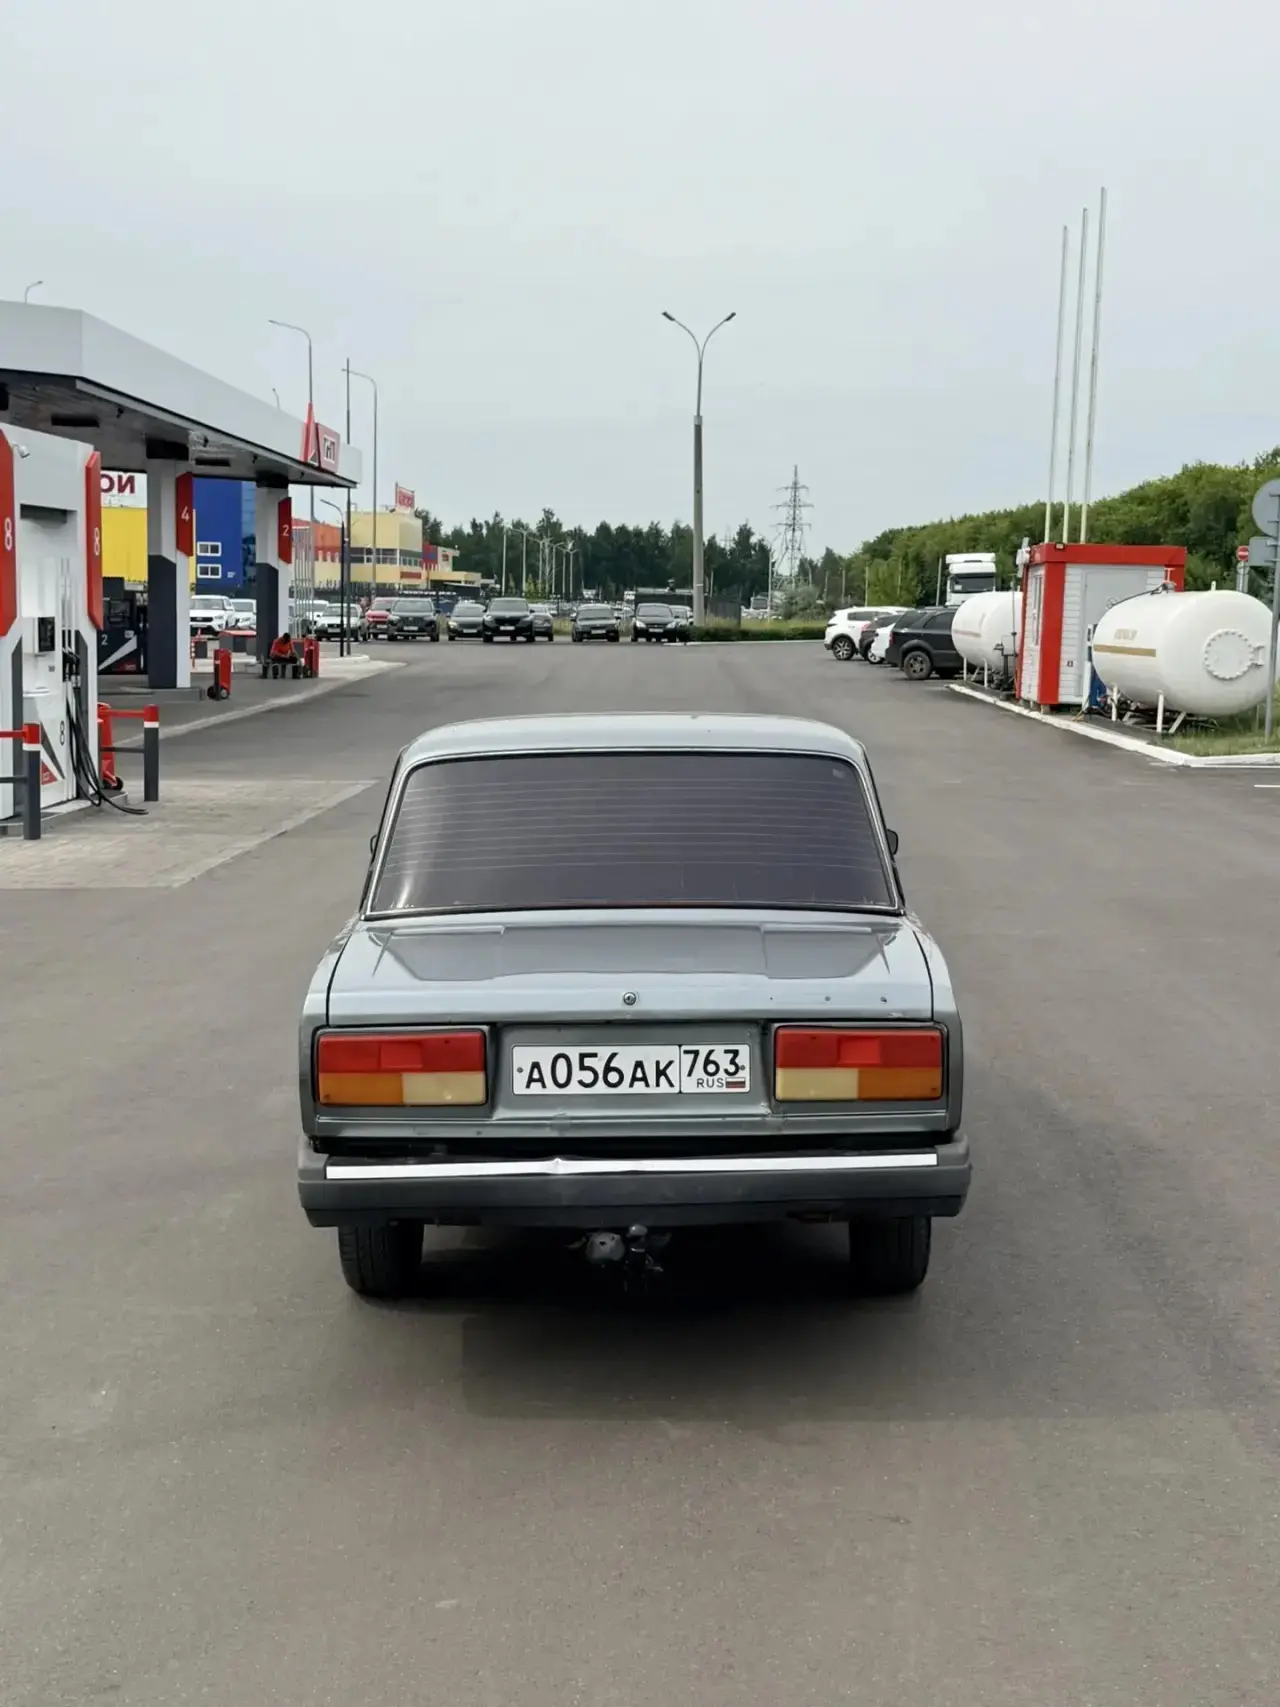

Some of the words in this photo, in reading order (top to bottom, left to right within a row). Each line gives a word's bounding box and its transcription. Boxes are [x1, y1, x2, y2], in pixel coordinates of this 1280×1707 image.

[181, 506, 190, 522] 4
[4, 517, 13, 551] 8
[282, 524, 290, 537] 2
[94, 527, 101, 556] 8
[101, 633, 109, 646] 2
[60, 720, 66, 746] 8
[525, 1052, 675, 1089] А056АК
[683, 1049, 741, 1077] 763
[696, 1077, 725, 1088] RUS
